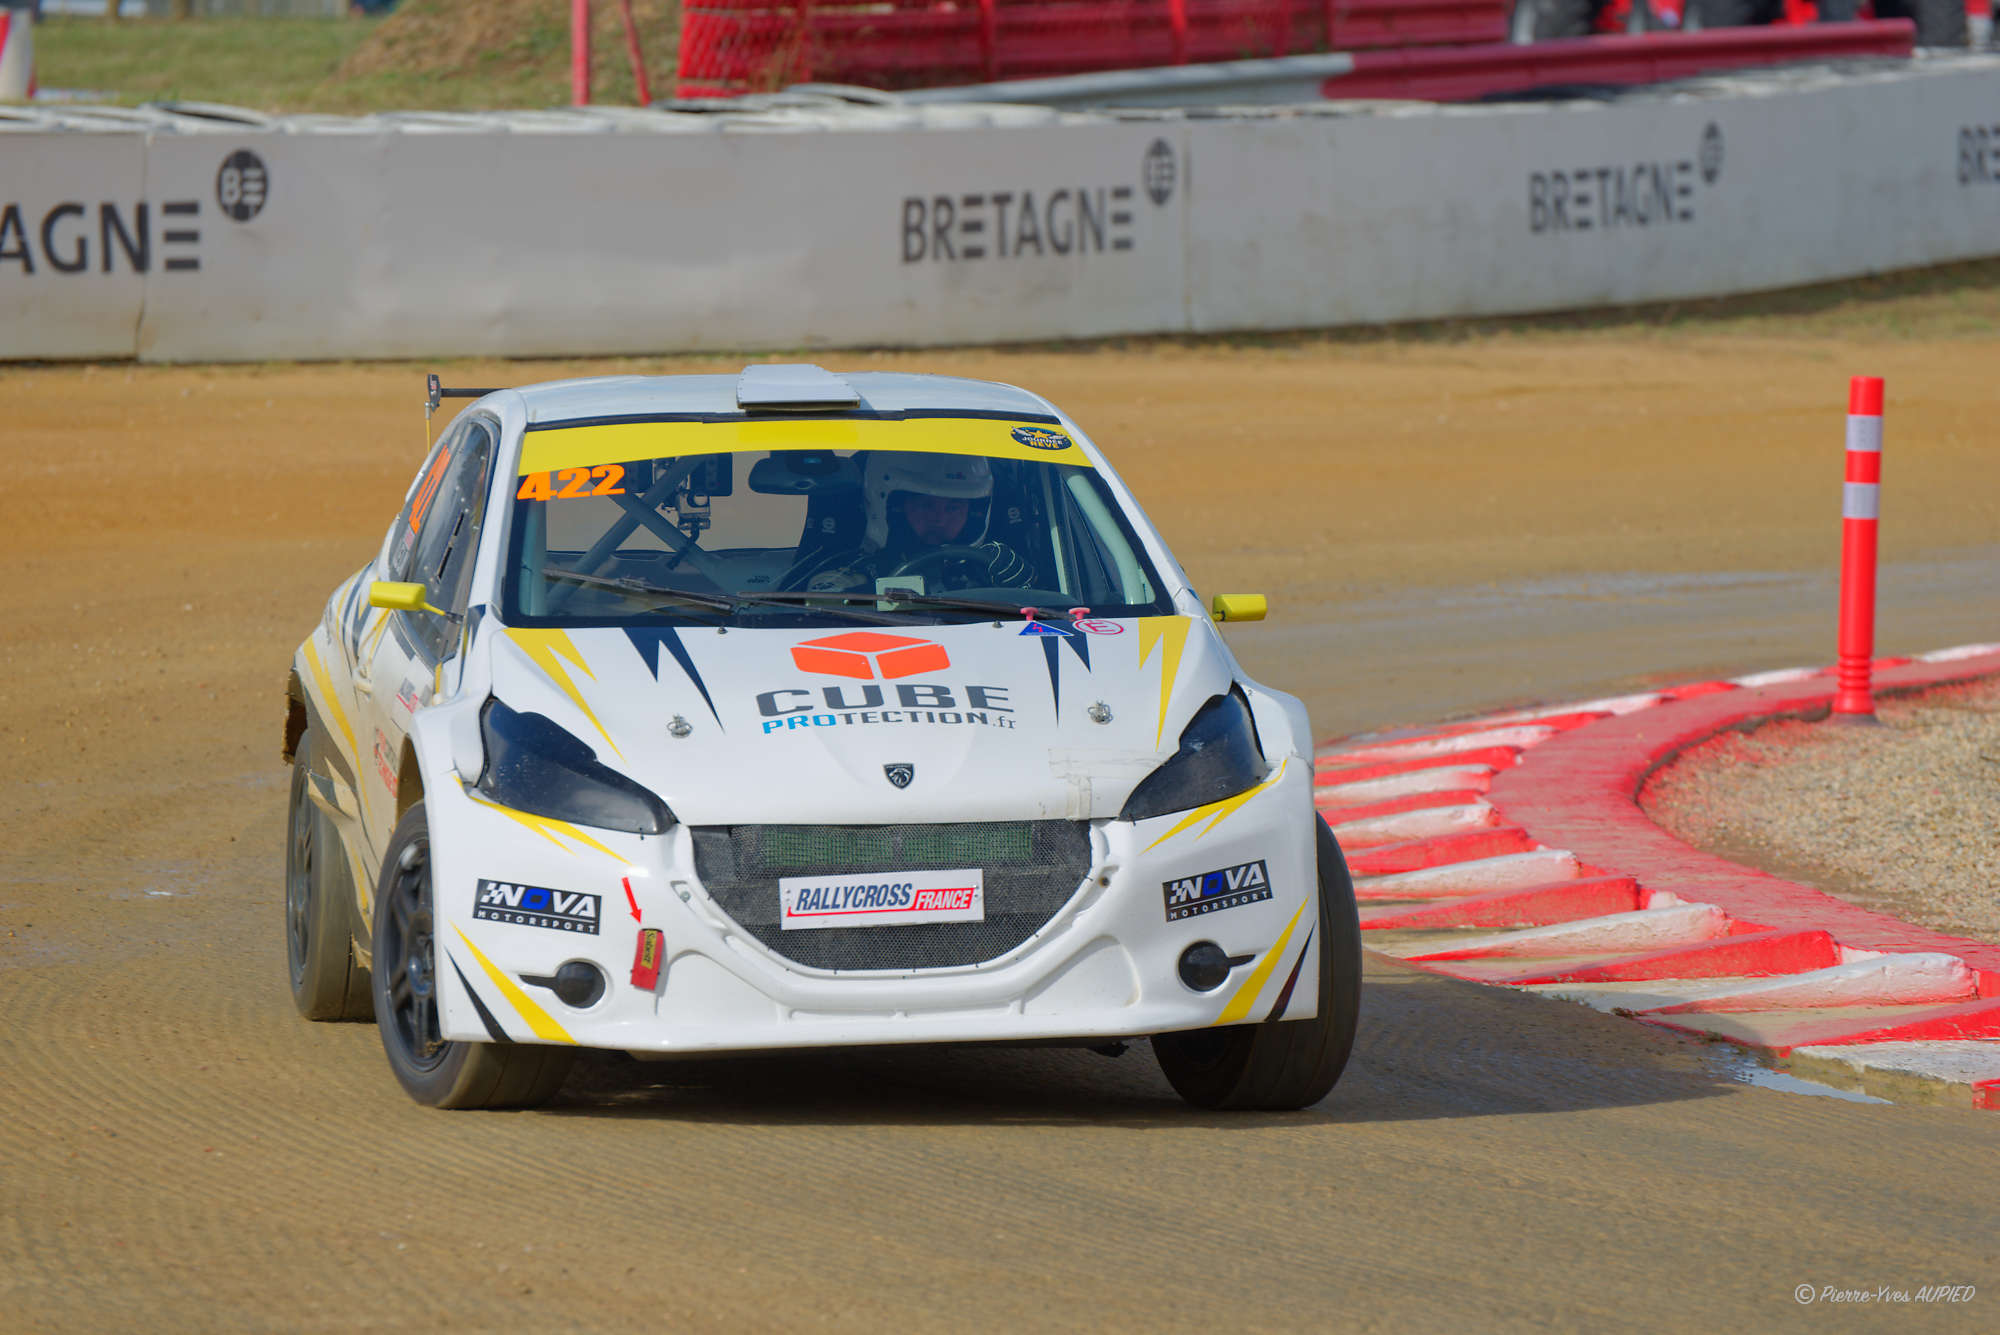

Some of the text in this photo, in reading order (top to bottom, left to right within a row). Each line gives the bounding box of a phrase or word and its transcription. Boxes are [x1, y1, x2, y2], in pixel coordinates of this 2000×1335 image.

[1529, 159, 1694, 234] BRETAGNE
[903, 186, 1133, 263] BRETAGNE
[516, 464, 626, 501] 422
[756, 684, 1014, 717] CUBE
[762, 711, 1016, 734] PROTECTION.fr
[796, 883, 913, 911] RALLYCROSS
[914, 889, 972, 910] FRANCE
[1170, 891, 1269, 920] MOTORSPORT
[477, 909, 596, 933] MOTORSPORT
